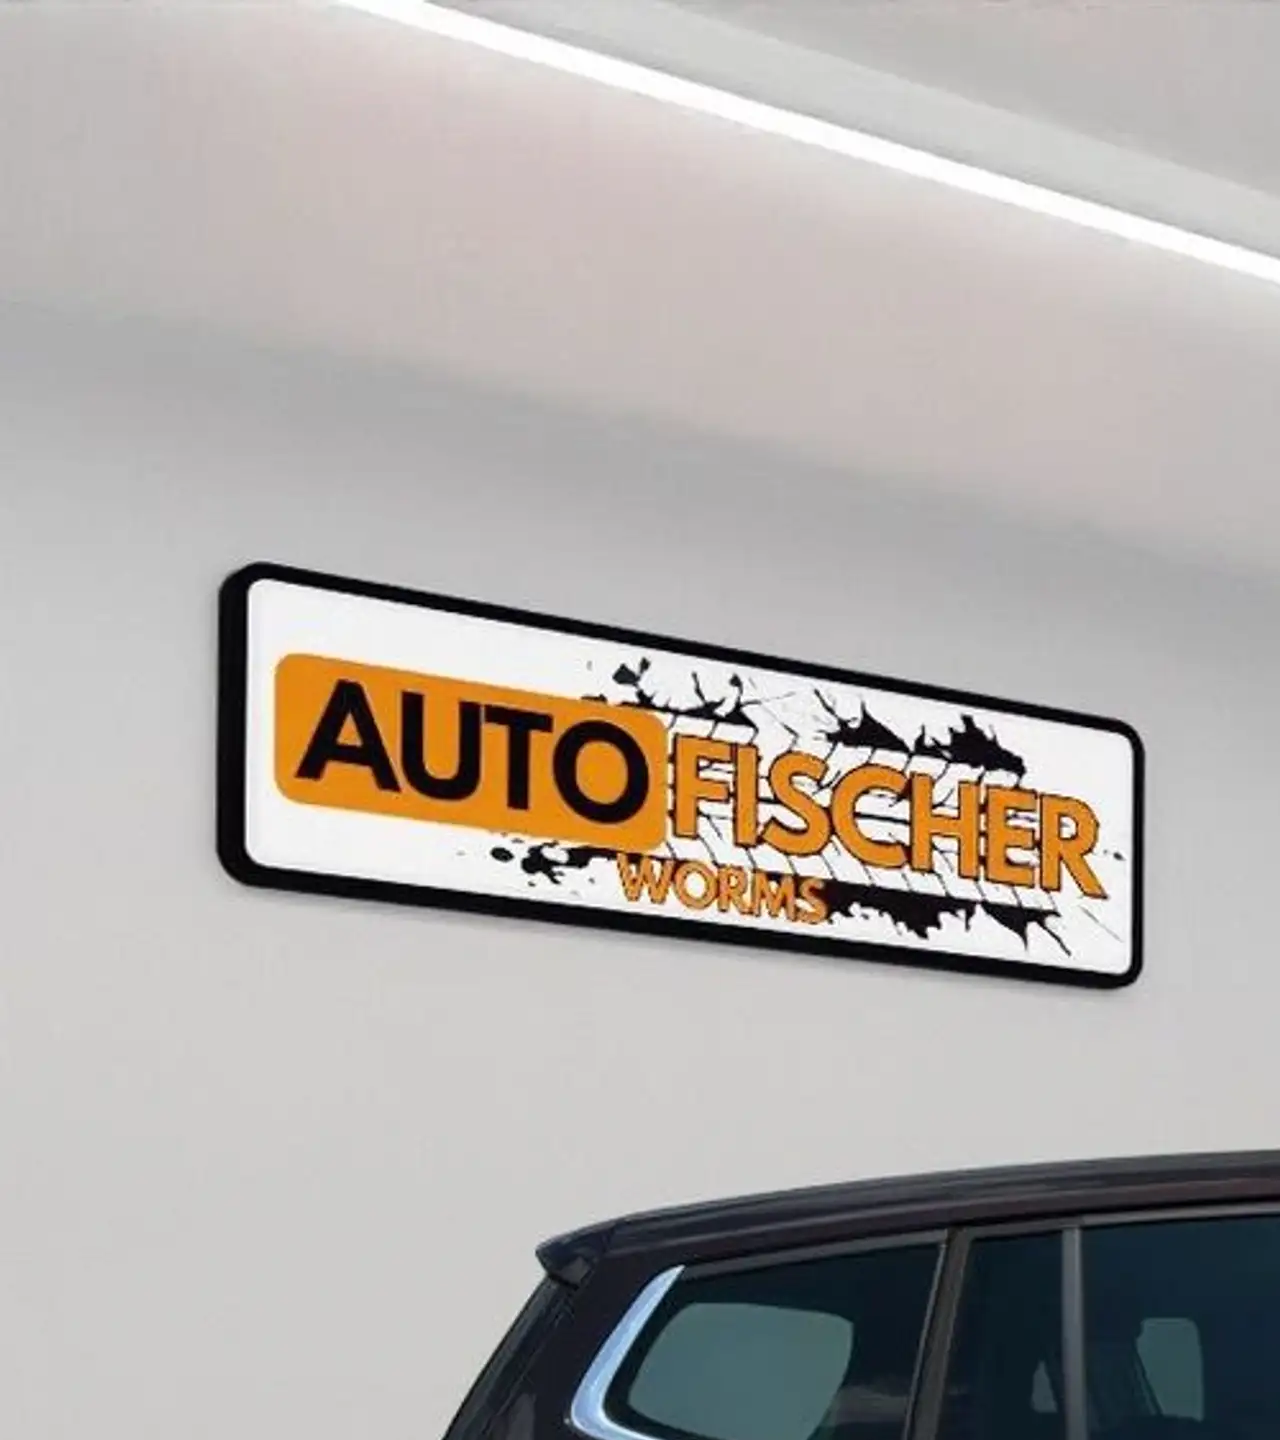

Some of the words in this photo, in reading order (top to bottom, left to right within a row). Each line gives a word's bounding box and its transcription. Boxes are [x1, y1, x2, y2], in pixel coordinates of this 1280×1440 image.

[295, 679, 650, 824] AUTO
[670, 733, 1109, 899] FISCHER
[615, 852, 830, 924] WORMS
